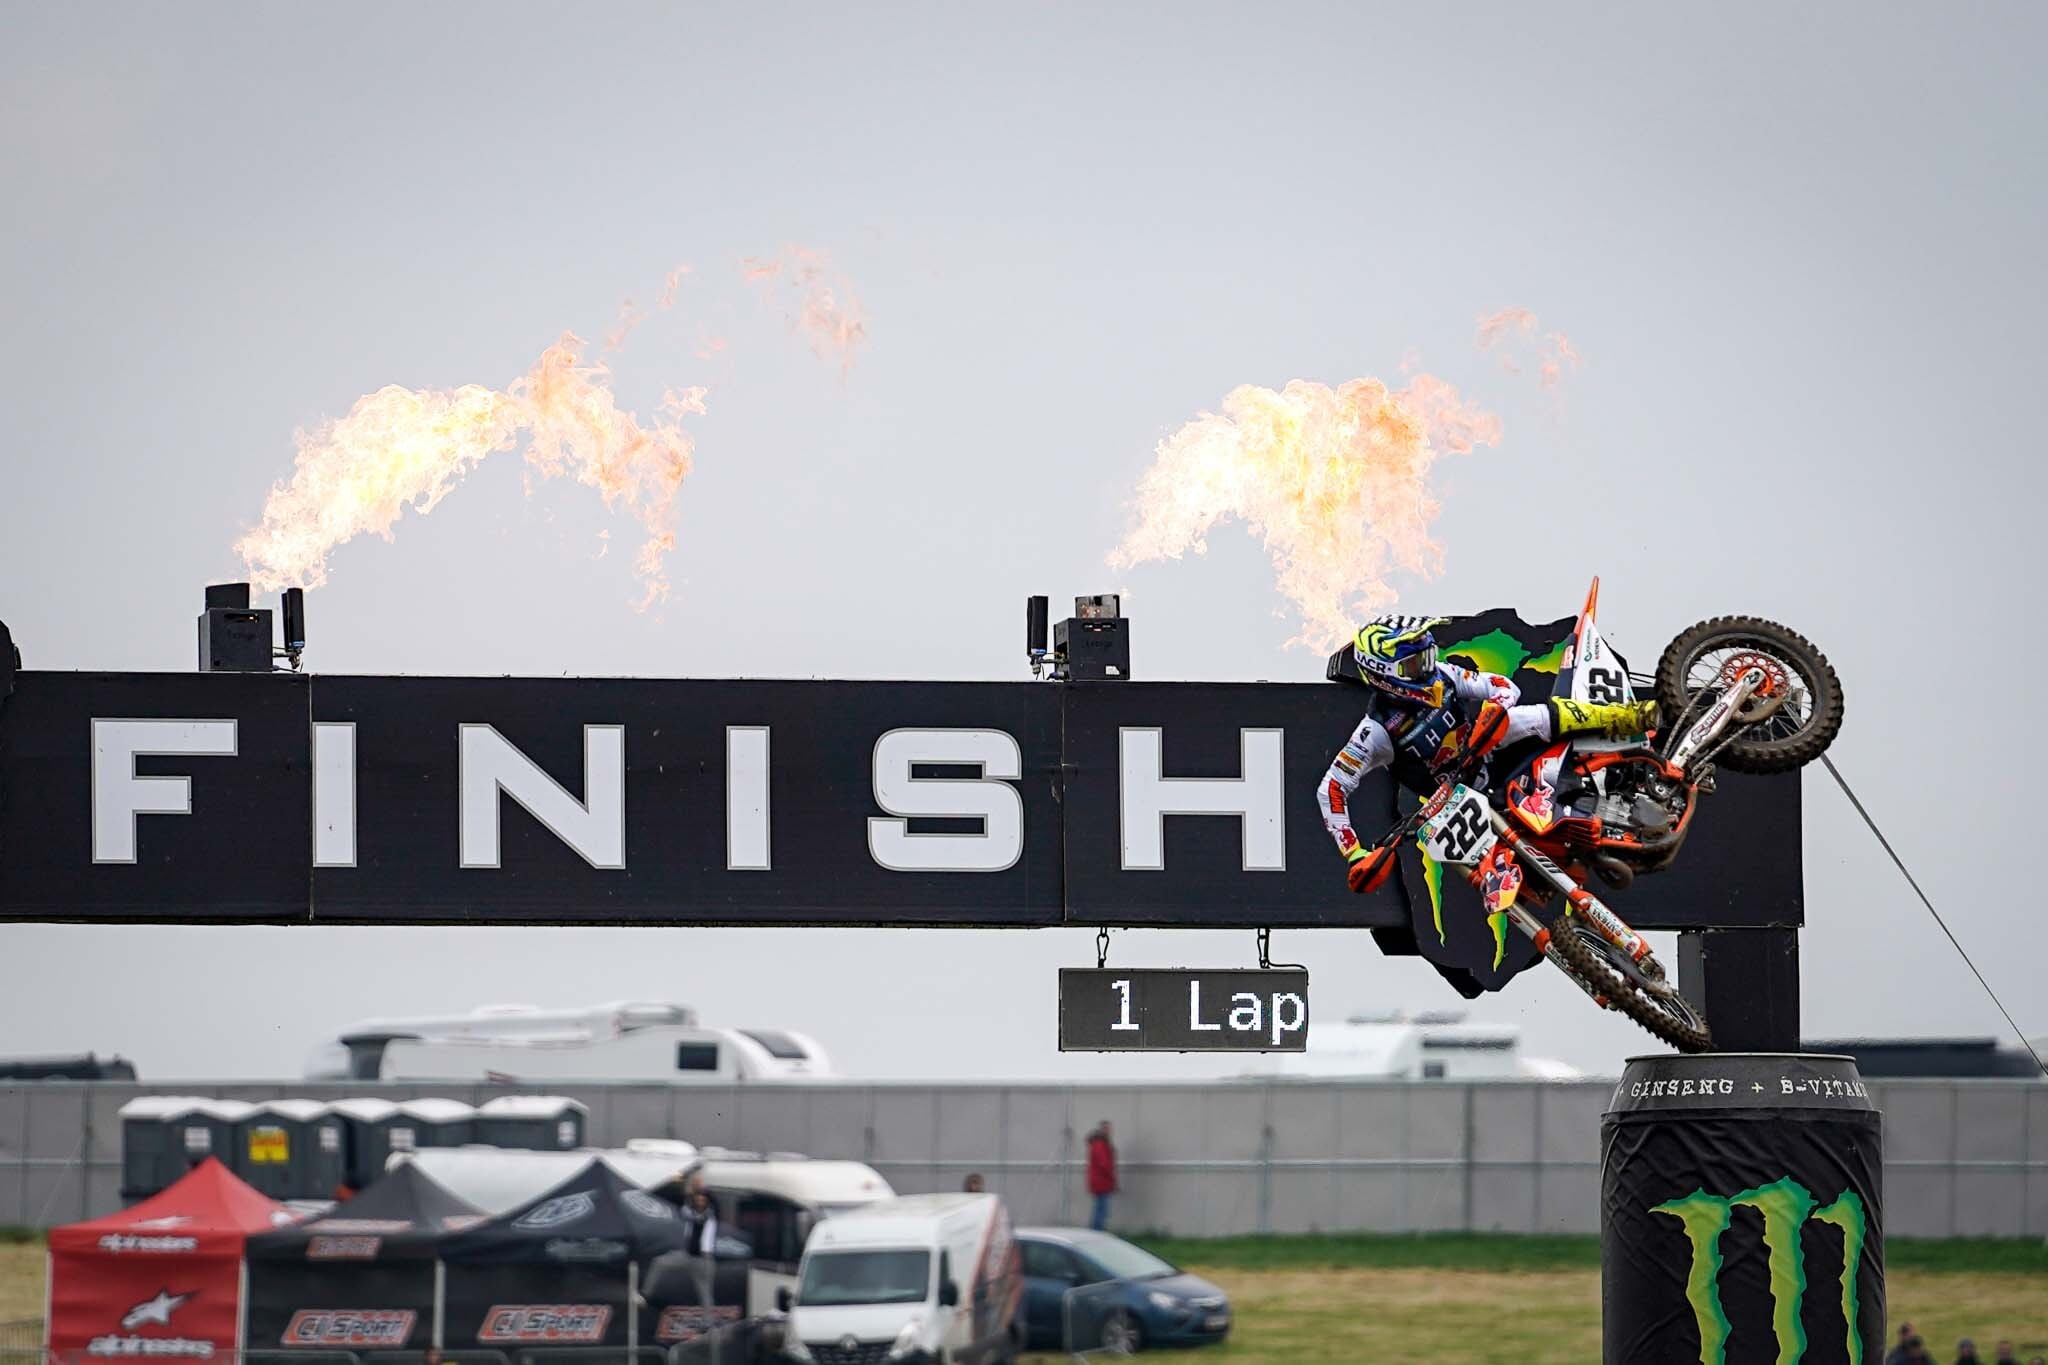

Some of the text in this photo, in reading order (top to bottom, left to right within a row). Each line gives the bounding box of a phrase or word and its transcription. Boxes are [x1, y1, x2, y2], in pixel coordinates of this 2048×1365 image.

[91, 717, 1286, 872] FINISH
[1435, 797, 1490, 861] 222
[1111, 979, 1305, 1046] 1 Lap
[1630, 1077, 1735, 1099] GINSENG
